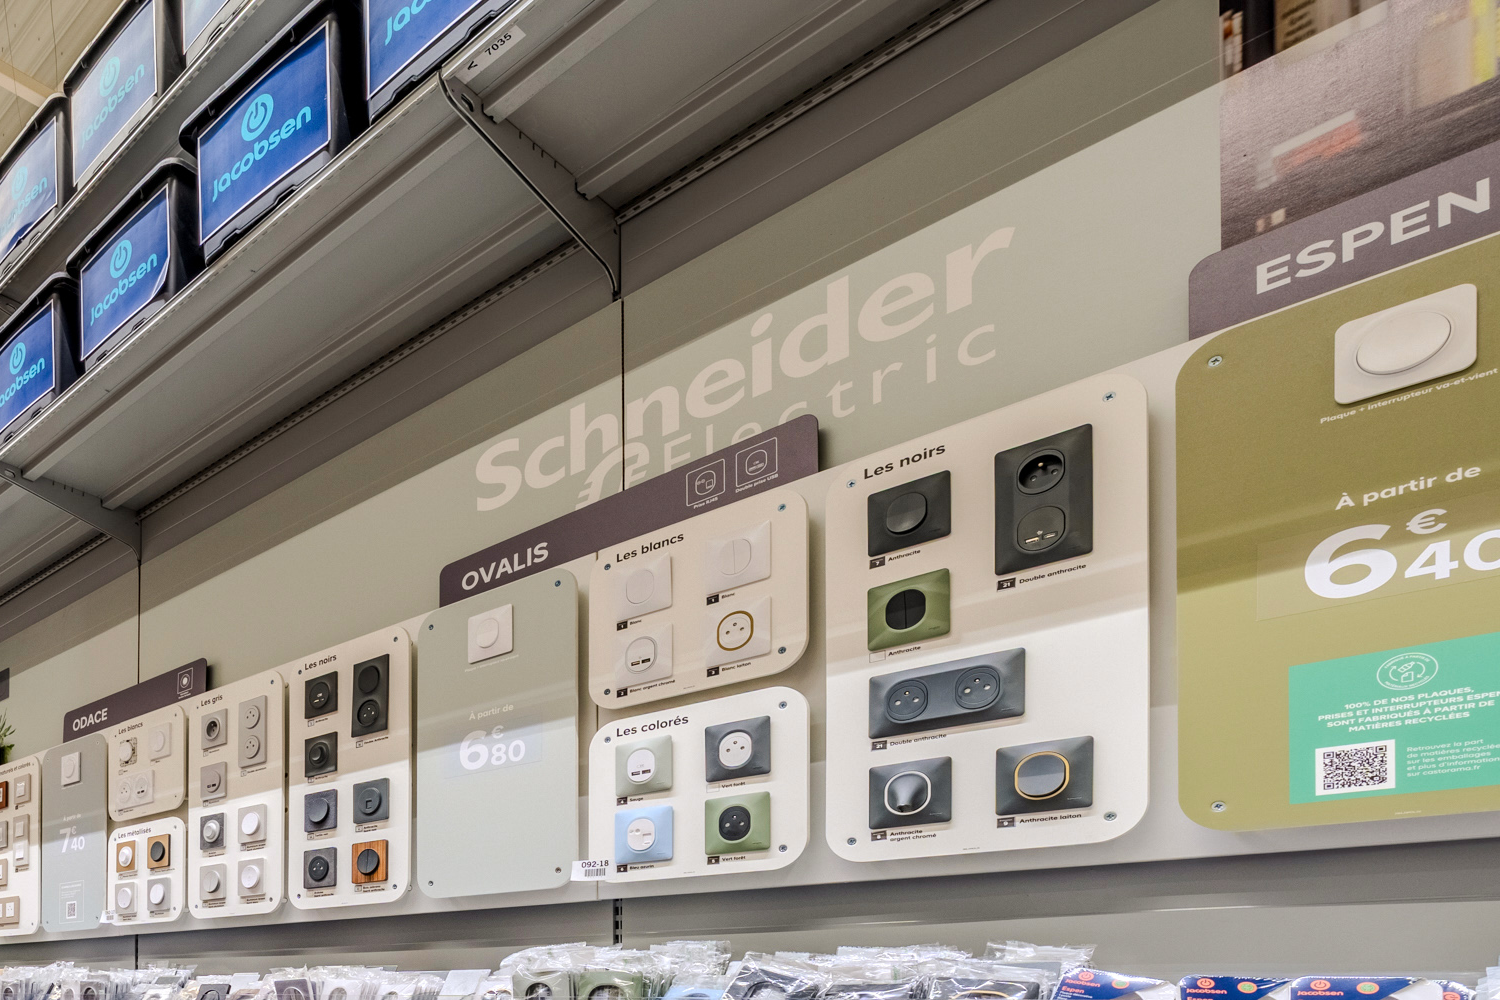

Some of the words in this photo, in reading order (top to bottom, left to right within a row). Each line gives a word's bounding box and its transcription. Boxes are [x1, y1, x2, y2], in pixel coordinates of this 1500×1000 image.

[485, 33, 512, 56] 7035
[1256, 177, 1490, 295] ESPEN
[476, 227, 1016, 512] Schneider
[1320, 408, 1357, 424] Plaque
[1367, 386, 1433, 411] interrupteur
[1435, 368, 1498, 391] va-et-vient
[864, 462, 894, 480] Les
[899, 444, 946, 468] noirs
[1335, 492, 1355, 511] À
[1363, 476, 1437, 507] partir
[1445, 466, 1481, 483] de
[616, 549, 637, 563] Les
[641, 533, 685, 554] blancs
[888, 549, 921, 562] Anthracite
[1304, 524, 1397, 599] 6
[1406, 508, 1447, 535] €
[461, 542, 549, 591] OVALIS
[1019, 573, 1045, 584] Double
[1047, 563, 1086, 577] anthracite
[888, 645, 921, 656] Anthracite
[305, 661, 317, 671] Les
[318, 654, 337, 668] noirs
[201, 698, 211, 707] Les
[212, 693, 223, 706] gris
[1318, 710, 1354, 721] PRISES
[1371, 696, 1464, 714] INTERRUPTEURS
[1344, 701, 1371, 710] 100%
[1391, 694, 1414, 704] NOS
[1418, 686, 1474, 701] PLAQUES,
[72, 708, 109, 731] ODACE
[469, 711, 476, 720] À
[477, 706, 501, 721] partir
[503, 703, 514, 713] de
[1327, 718, 1356, 728] SONT
[1358, 709, 1420, 723] FABRIQUÉS
[1434, 702, 1475, 713] PARTIR
[1349, 720, 1402, 732] MATIÈRES
[1405, 710, 1470, 725] RECYCLÉES
[127, 721, 143, 732] blancs
[616, 727, 637, 737] Les
[641, 714, 689, 732] colorés
[459, 730, 489, 770] 6
[491, 740, 526, 766] 80
[890, 738, 912, 747] Double
[914, 732, 947, 743] anthracite
[1407, 743, 1451, 752] Retrouvez
[1464, 739, 1484, 748] part
[1437, 751, 1491, 762] emballages
[1423, 765, 1481, 776] castorama.fr
[1019, 815, 1058, 824] Anthracite
[1059, 813, 1082, 821] laiton
[59, 827, 71, 853] 7
[71, 836, 85, 850] 40
[118, 832, 127, 840] Les
[127, 826, 152, 838] métallisés
[890, 829, 923, 837] Anthracite
[581, 860, 609, 868] 092-18
